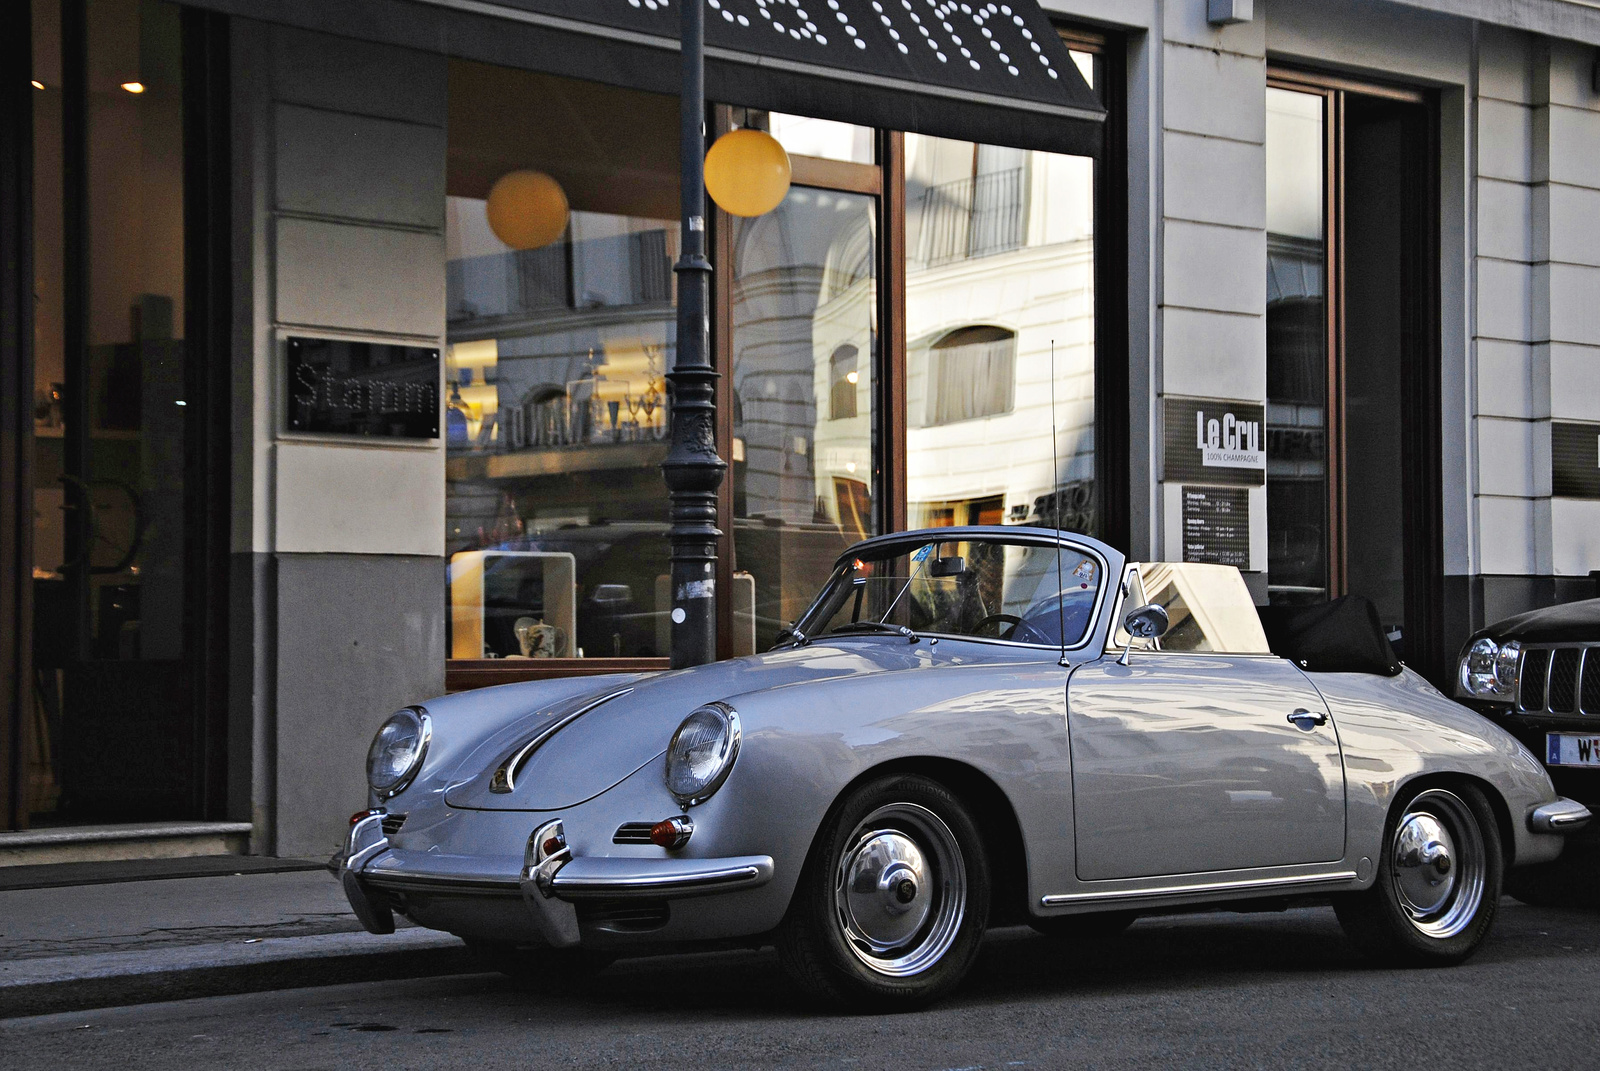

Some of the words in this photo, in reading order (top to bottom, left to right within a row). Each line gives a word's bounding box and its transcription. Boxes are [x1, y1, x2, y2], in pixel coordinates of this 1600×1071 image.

[295, 363, 435, 414] Stamm
[1206, 452, 1222, 462] 100%
[1223, 453, 1259, 464] CHAMPAGNE
[1578, 738, 1592, 762] W
[898, 782, 953, 803] UNIROYAL
